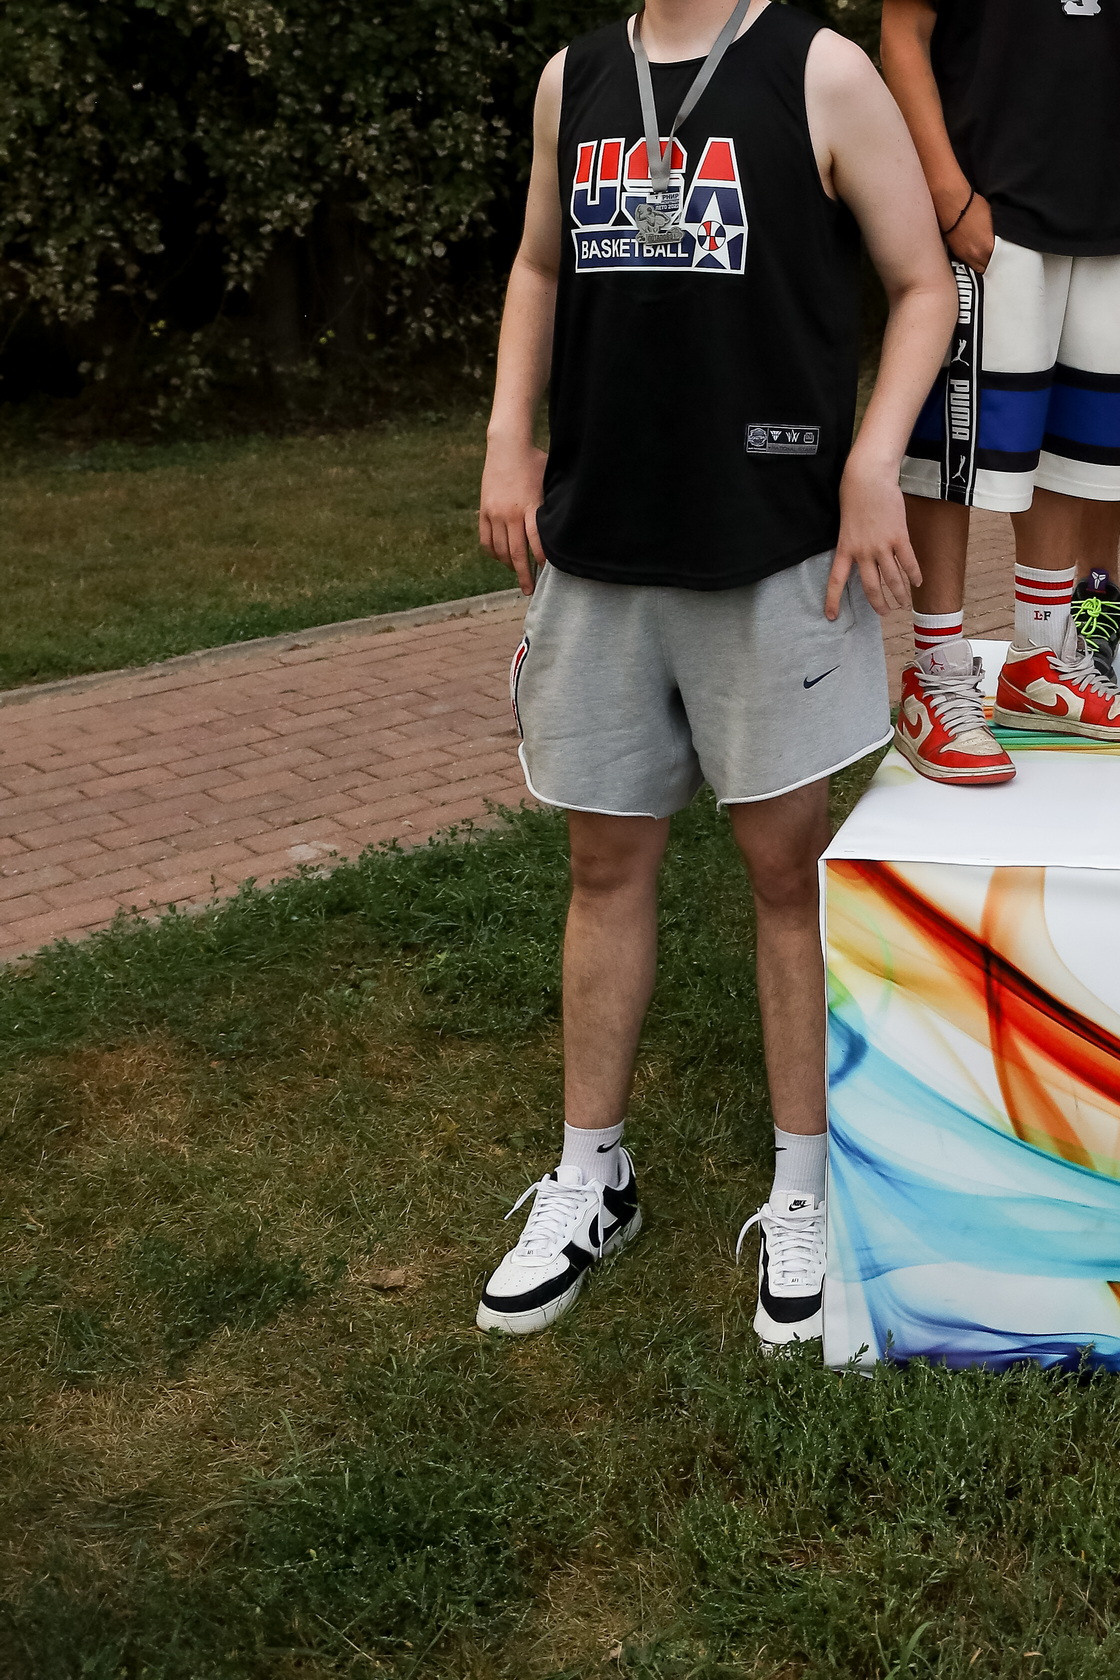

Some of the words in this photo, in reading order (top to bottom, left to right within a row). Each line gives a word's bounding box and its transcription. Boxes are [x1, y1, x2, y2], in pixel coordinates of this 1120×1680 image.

[571, 136, 748, 274] USA
[581, 238, 689, 260] BASKETBALL
[950, 379, 970, 441] PUMA
